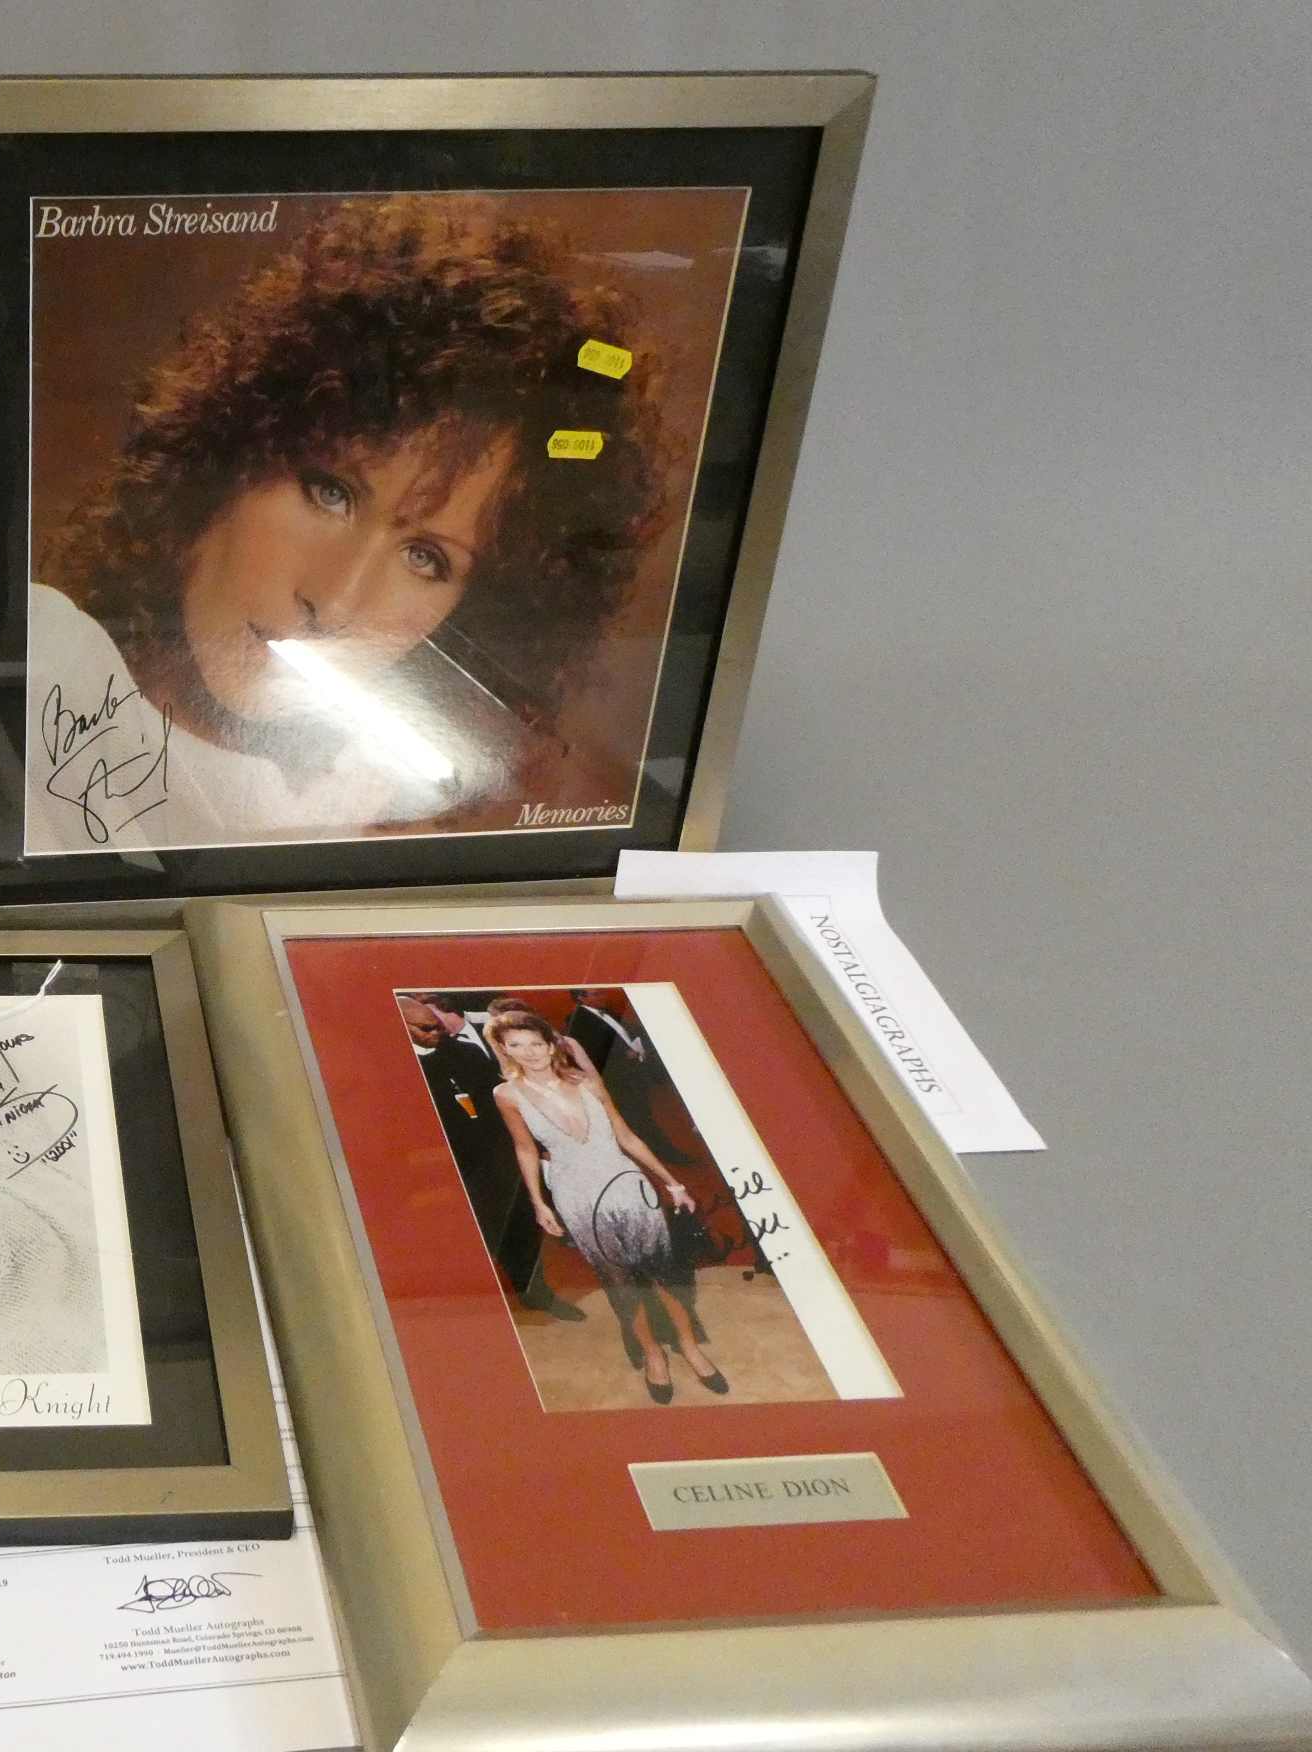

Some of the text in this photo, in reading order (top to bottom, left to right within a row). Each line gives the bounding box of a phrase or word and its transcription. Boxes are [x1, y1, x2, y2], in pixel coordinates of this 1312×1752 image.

[36, 200, 279, 237] Barbra Streisand
[514, 799, 629, 827] Memories
[809, 913, 942, 1094] NOSTALGIAGRAPHS
[673, 1477, 851, 1504] CELINE DION
[103, 1555, 131, 1565] Todd
[134, 1551, 175, 1562] Mueller,
[177, 1547, 223, 1558] President
[131, 1617, 265, 1637] Todd Mueller Autographs
[130, 1638, 171, 1648] Huntsman
[195, 1631, 231, 1641] Colorado
[120, 1650, 291, 1671] www.ToddMuellerAutographs.com
